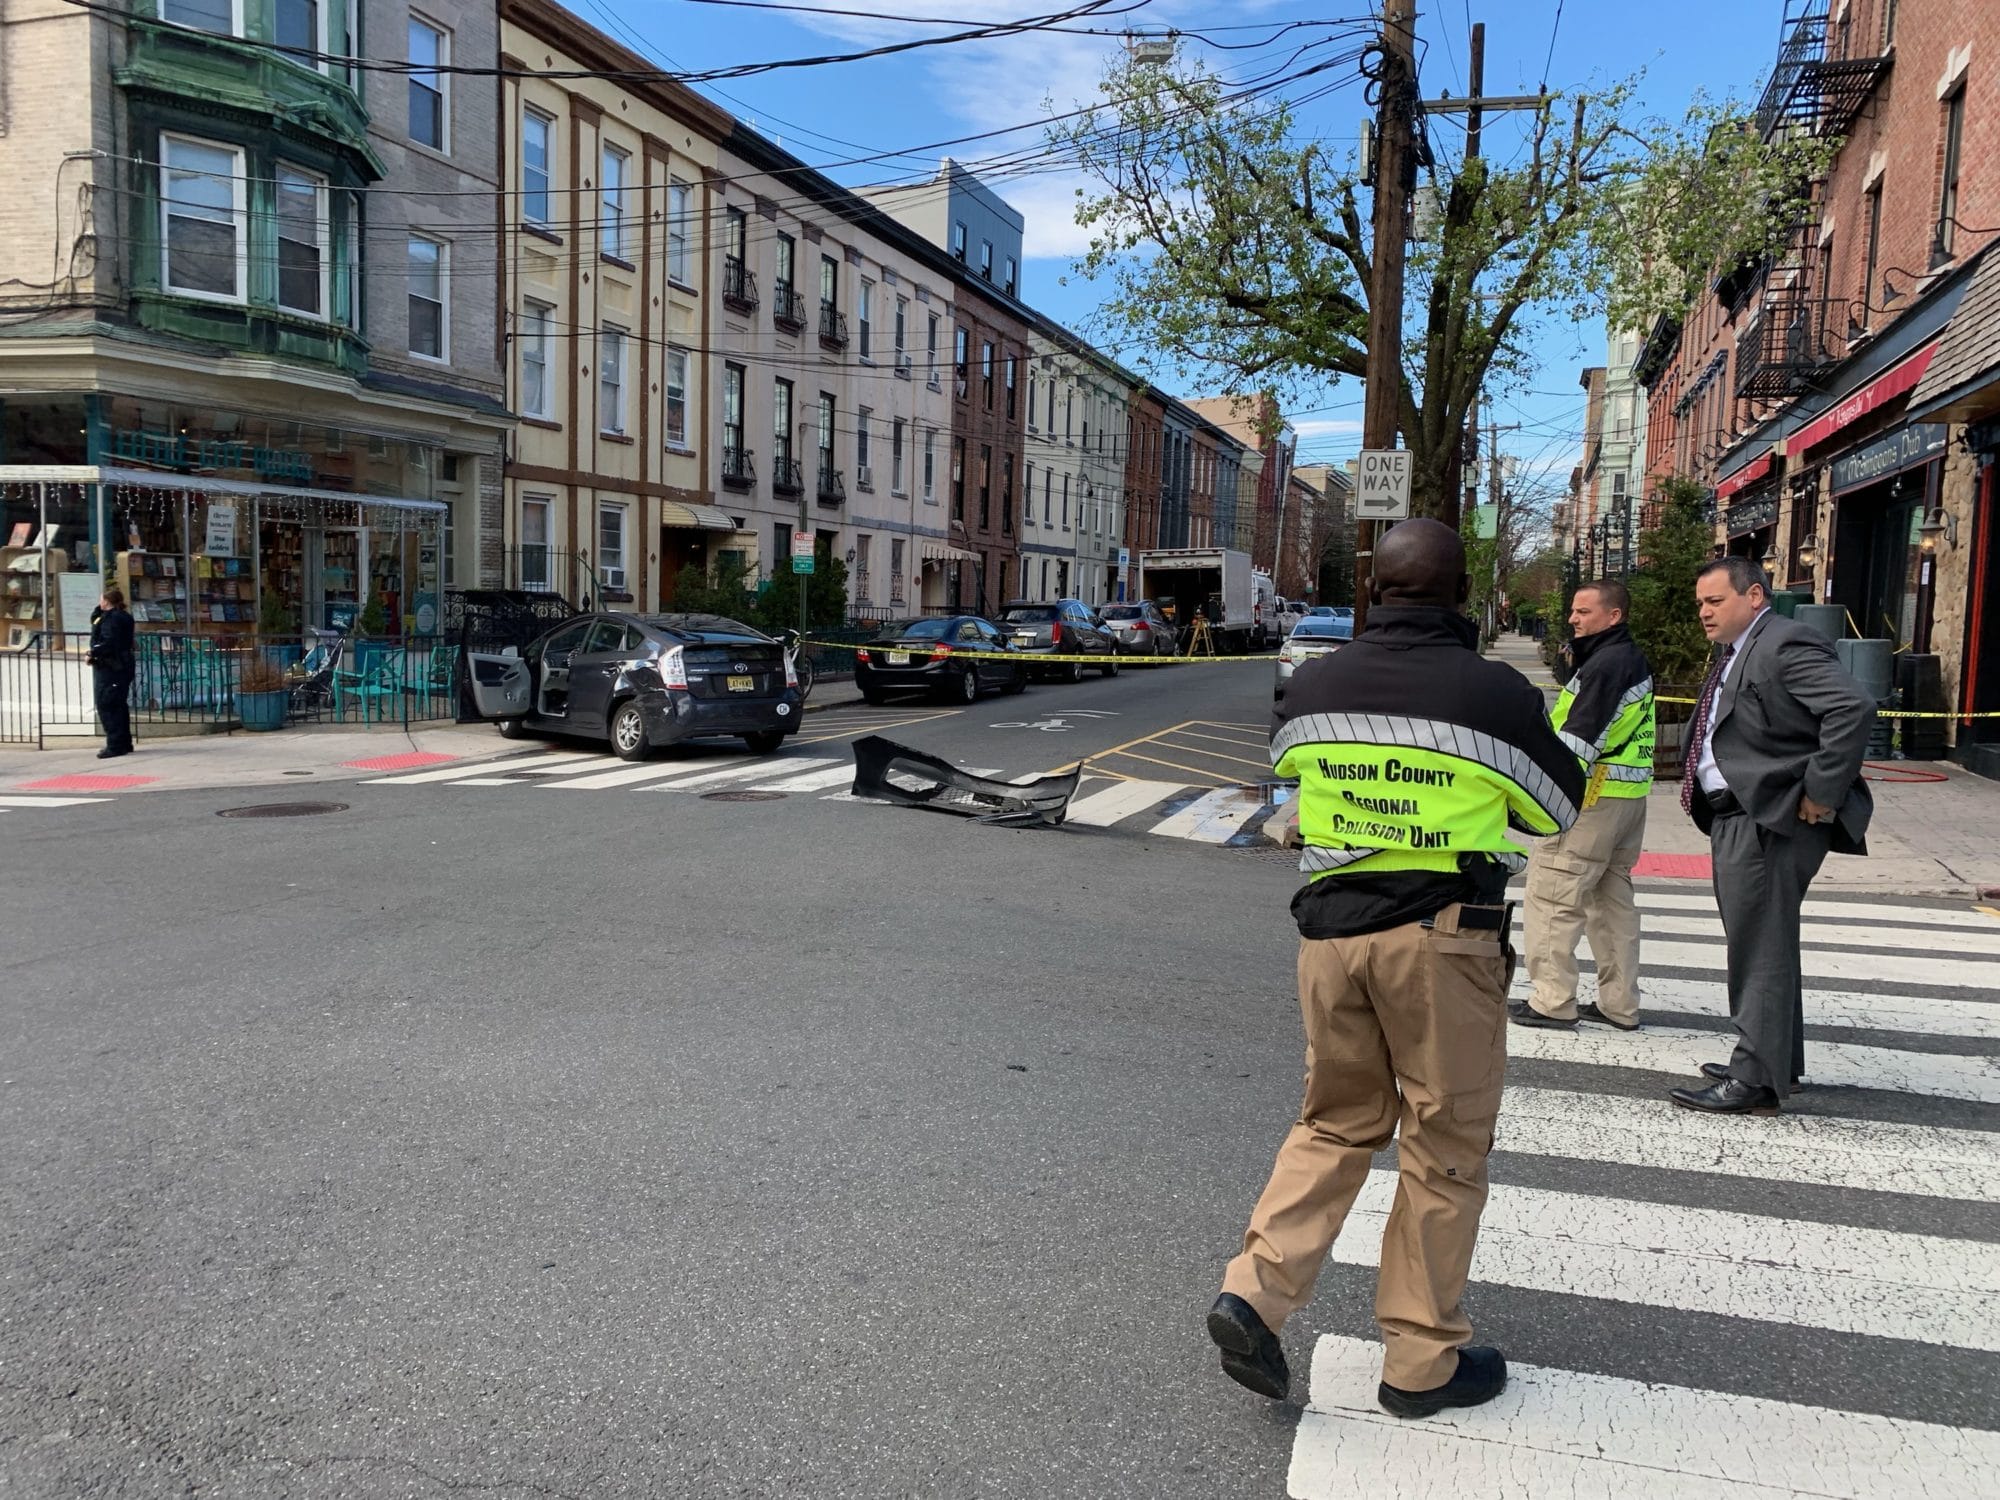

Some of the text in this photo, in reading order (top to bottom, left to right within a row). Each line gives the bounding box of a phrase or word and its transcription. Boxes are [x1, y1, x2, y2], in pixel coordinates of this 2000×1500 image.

[1366, 456, 1404, 472] ONE
[1364, 475, 1404, 491] WAY
[1317, 758, 1456, 787] HUDSON COUNTY
[1342, 790, 1420, 815] REGIONAL
[1332, 814, 1452, 848] COLLISION UNIT
